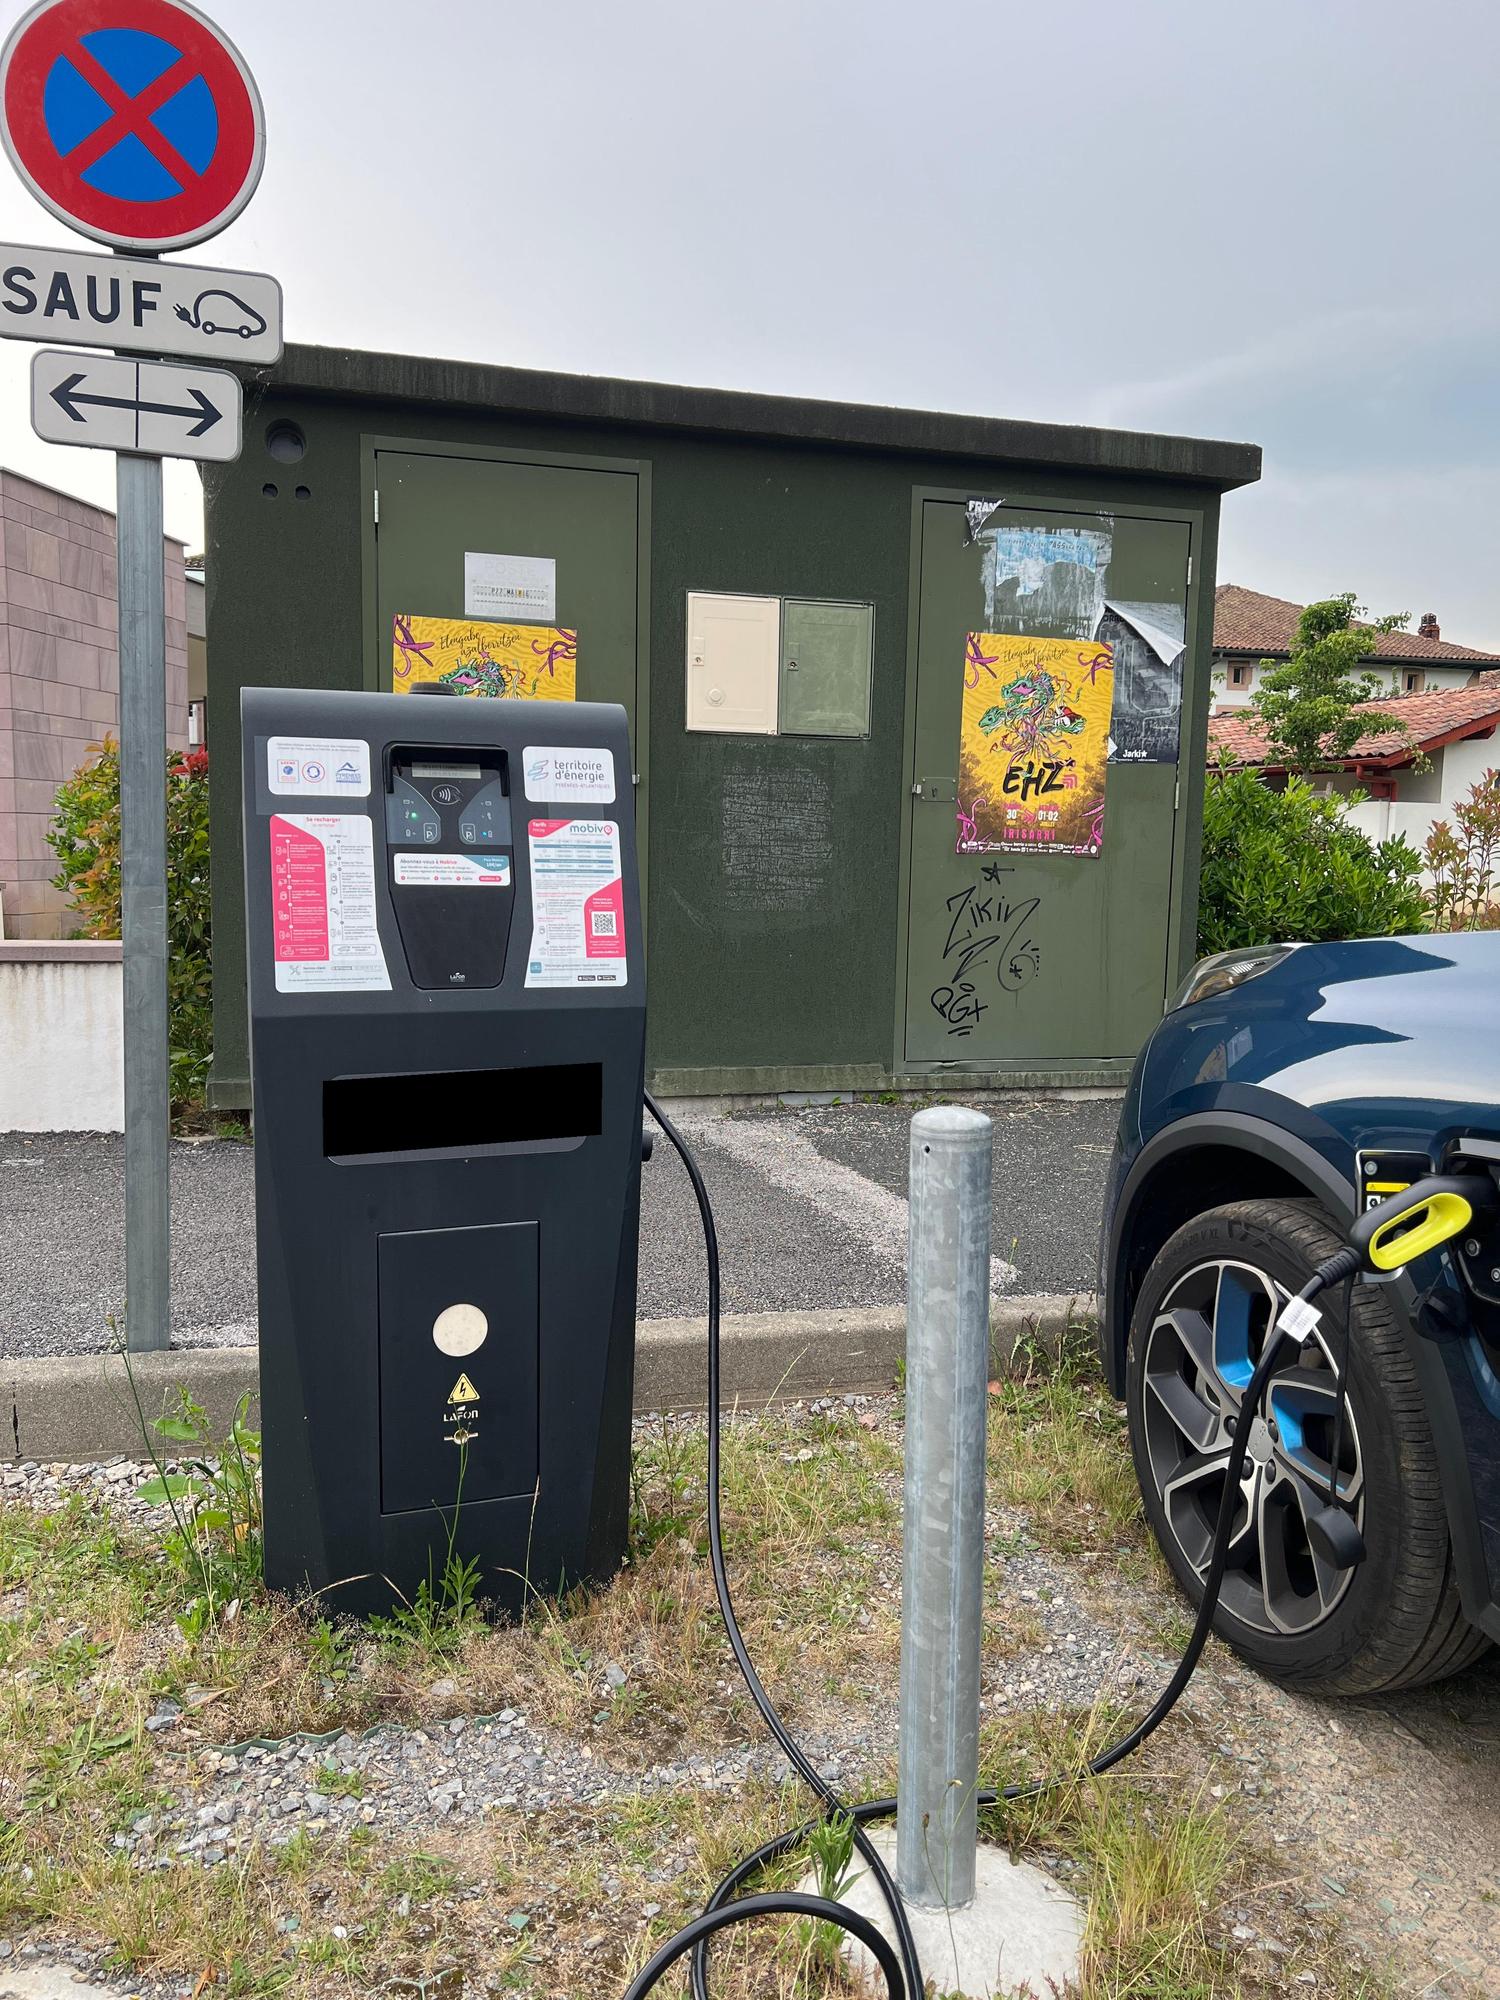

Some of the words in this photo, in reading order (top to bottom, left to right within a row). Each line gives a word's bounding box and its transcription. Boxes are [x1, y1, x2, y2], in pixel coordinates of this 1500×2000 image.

[2, 266, 162, 327] SAUF
[554, 760, 603, 771] territoire
[555, 771, 605, 783] d'énergie
[1002, 760, 1064, 801] EHZ
[1006, 809, 1017, 819] 30
